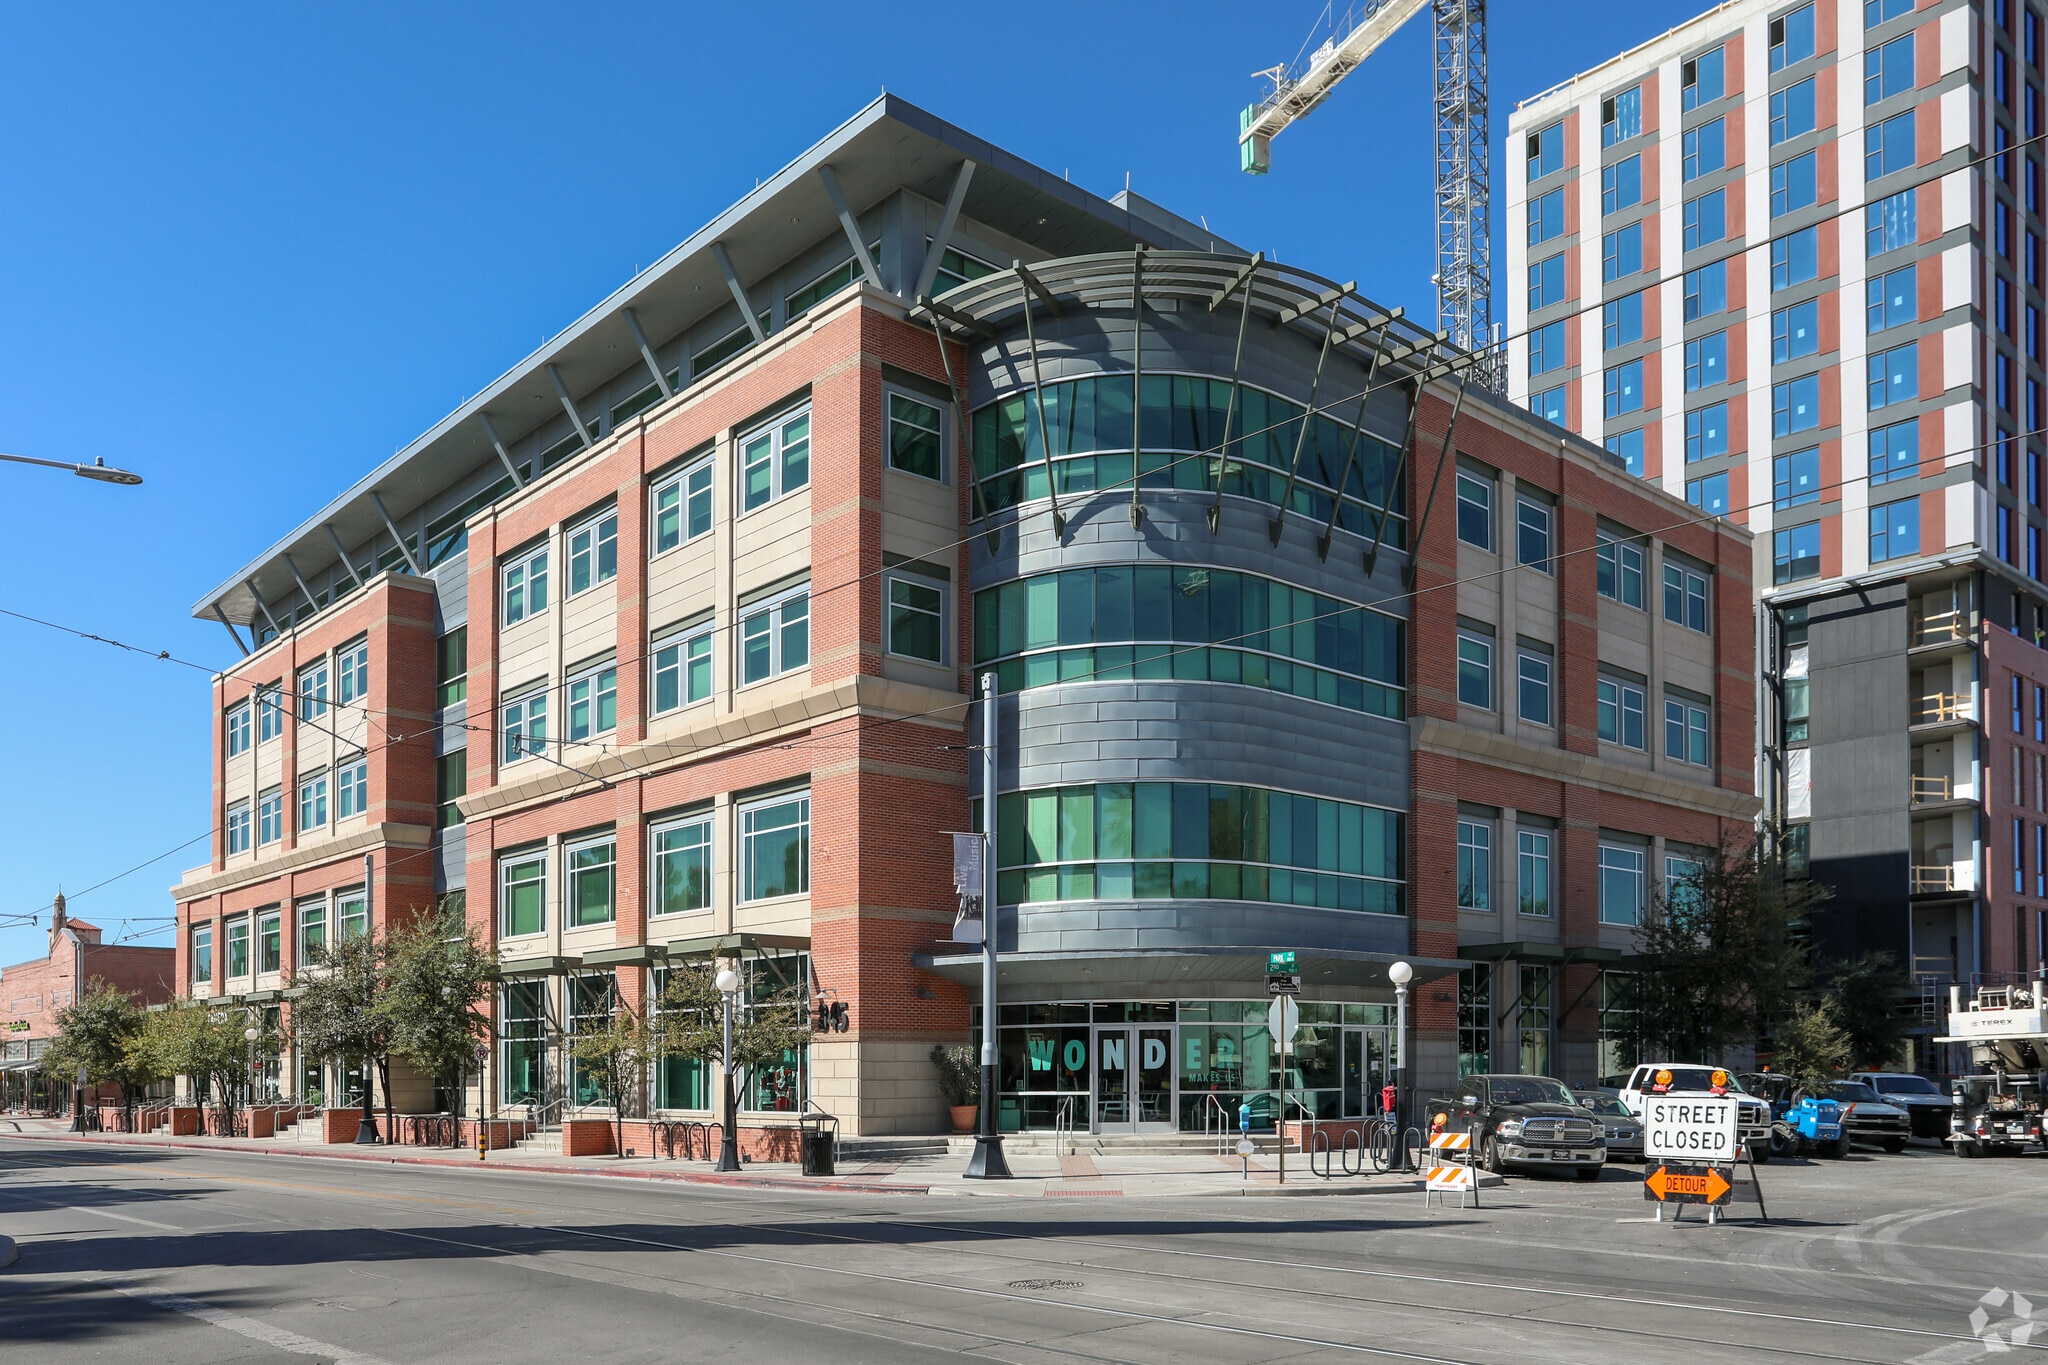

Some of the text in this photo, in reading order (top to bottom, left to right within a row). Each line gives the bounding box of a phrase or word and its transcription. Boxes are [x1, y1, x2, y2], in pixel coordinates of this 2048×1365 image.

[969, 838, 979, 871] Music
[960, 865, 968, 888] Live
[1029, 1038, 1235, 1071] WONDER
[1189, 1073, 1236, 1082] MAKES US
[1654, 1105, 1728, 1124] STREET
[1652, 1130, 1726, 1150] CLOSED
[1666, 1177, 1707, 1192] DETOUR
